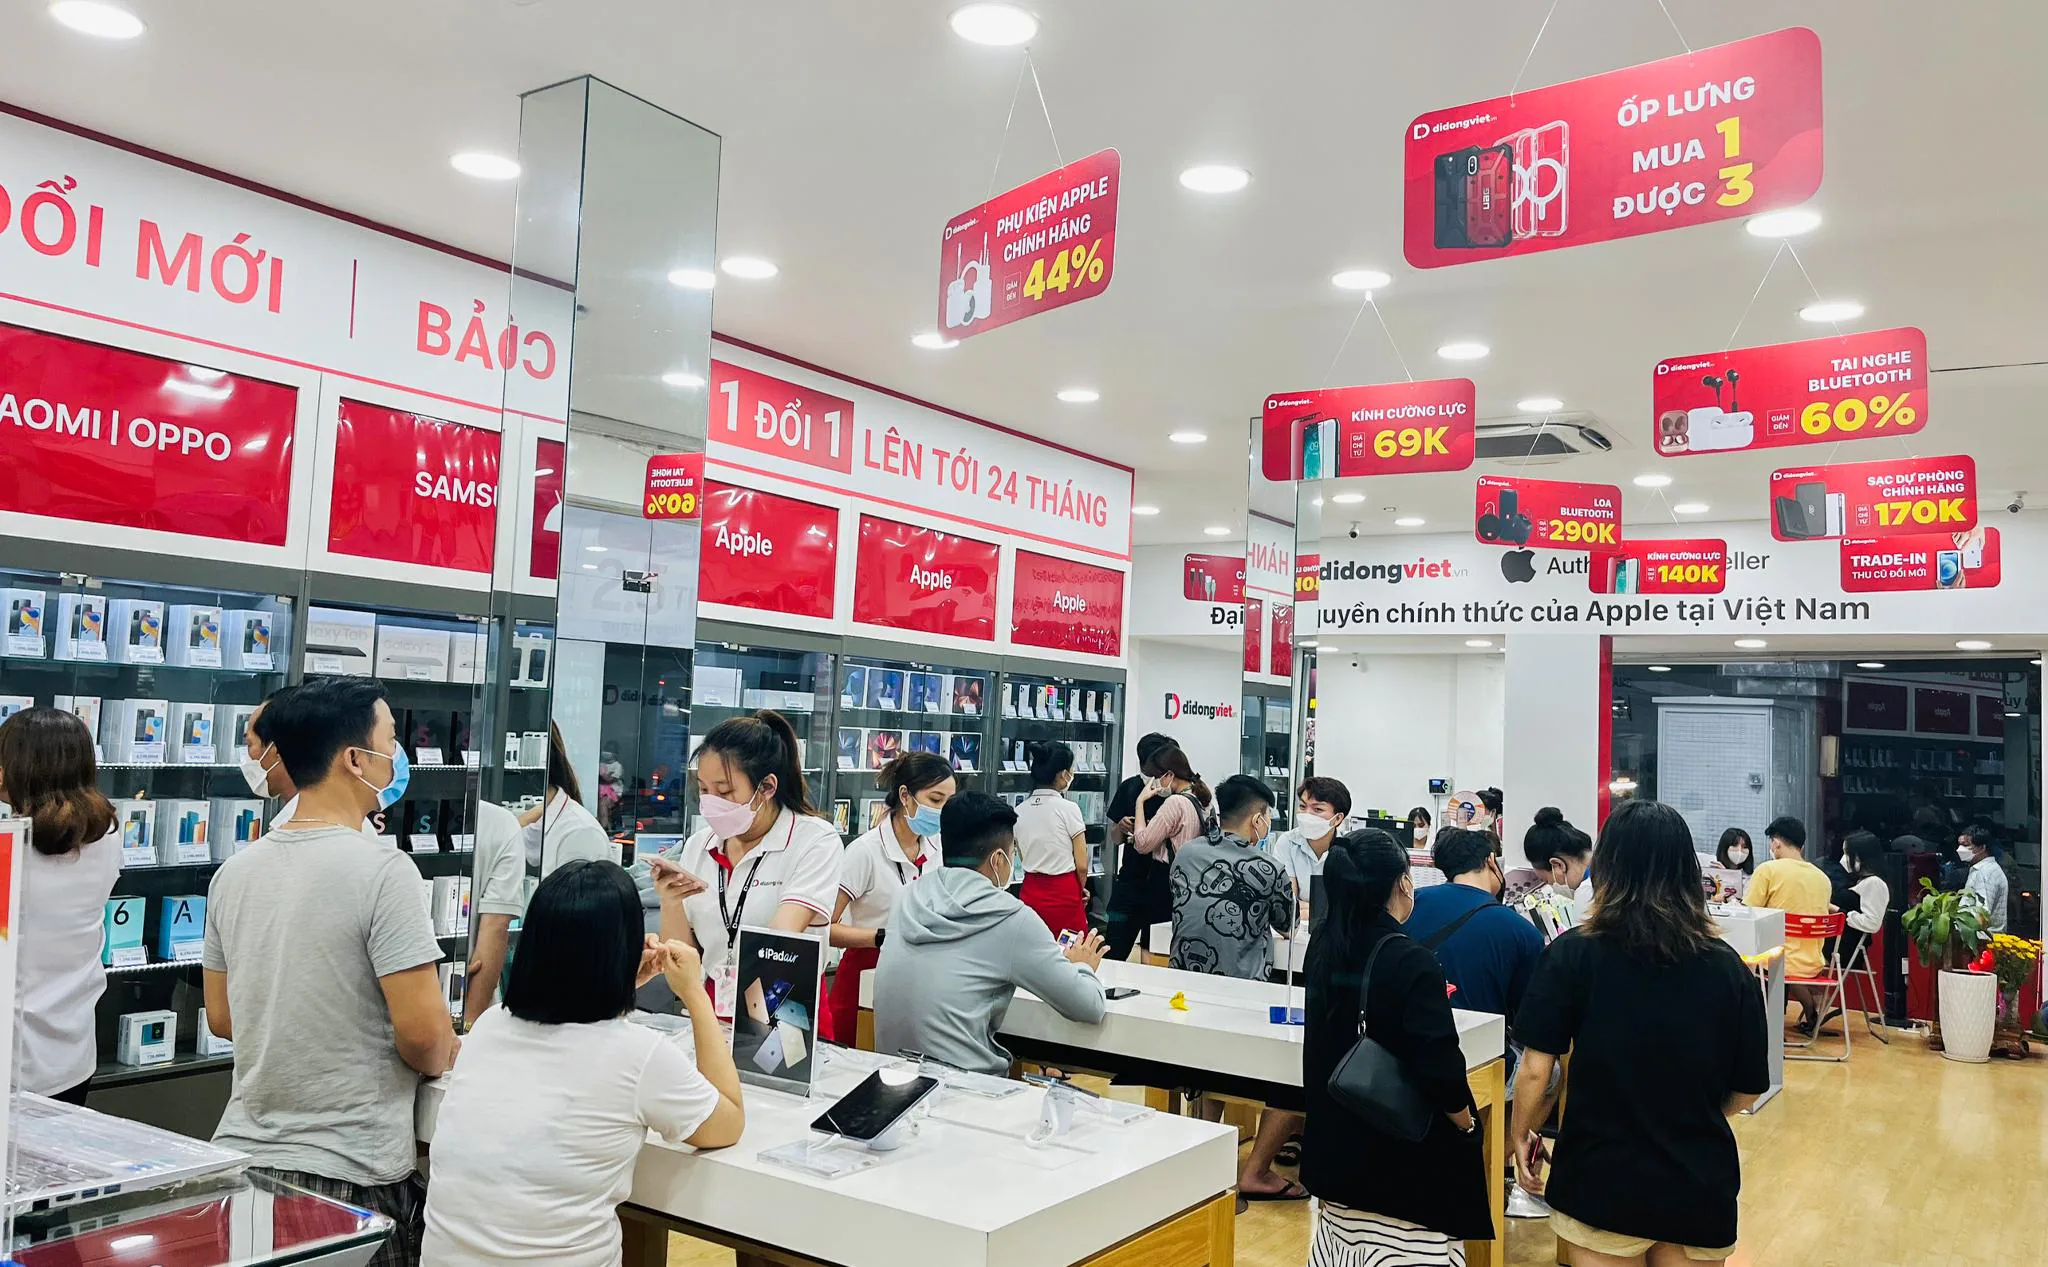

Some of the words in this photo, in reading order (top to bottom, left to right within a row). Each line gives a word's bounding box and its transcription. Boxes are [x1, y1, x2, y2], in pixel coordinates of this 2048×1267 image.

[1617, 95, 1660, 127] ỐP
[1667, 76, 1755, 116] LƯNG
[1632, 138, 1706, 173] MUA
[1715, 116, 1740, 159] 1
[1612, 181, 1706, 219] ĐƯỢC
[1716, 162, 1754, 207] 3
[996, 212, 1023, 238] PHỤ
[1025, 196, 1058, 224] KIỆN
[1059, 176, 1109, 211] APPLE
[0, 175, 104, 267] ỔI
[136, 219, 283, 314] MỚI
[1003, 230, 1046, 262] CHÍNH
[1048, 213, 1092, 246] HÃNG
[1023, 238, 1104, 301] 44%
[1831, 355, 1859, 372] TAI
[1862, 350, 1912, 368] NGHE
[1808, 368, 1912, 392] BLUETOOTH
[720, 380, 739, 432] 1
[754, 398, 811, 451] ĐỔI
[824, 410, 840, 458] 1
[1351, 408, 1384, 422] KÍNH
[1386, 404, 1435, 419] CƯỜNG
[1438, 402, 1467, 418] LỰC
[1800, 392, 1916, 435] 60%
[0, 393, 102, 440] AOMI
[128, 417, 232, 461] OPPO
[1373, 426, 1449, 458] 69K
[864, 426, 923, 480] LÊN
[932, 447, 978, 494] TỚI
[988, 465, 1018, 504] 24
[1026, 478, 1108, 527] THÁNG
[1867, 474, 1894, 488] SẠC
[1895, 471, 1917, 486] DỰ
[1918, 469, 1964, 483] PHÒNG
[1882, 484, 1925, 497] CHÍNH
[1926, 481, 1965, 494] HÃNG
[415, 471, 496, 508] SAMS
[1560, 507, 1614, 519] BLUETOOTH
[1593, 498, 1612, 508] LOA
[1874, 498, 1968, 526] 170K
[715, 526, 773, 557] Apple
[1549, 519, 1616, 544] 290K
[1647, 552, 1669, 560] KÍNH
[1703, 552, 1721, 561] LỰC
[1851, 553, 1927, 567] TRADE-IN
[910, 565, 952, 590] Apple
[1658, 565, 1719, 583] 140K
[1852, 570, 1872, 579] THU
[1873, 568, 1888, 578] CŨ
[1889, 567, 1907, 578] ĐỔI
[1908, 566, 1927, 577] MỚI
[1053, 591, 1086, 612] Apple
[1210, 605, 1244, 629] Đại
[1318, 601, 1380, 629] uyền
[1386, 602, 1455, 624] chính
[1463, 600, 1524, 623] thức
[1530, 599, 1578, 622] của
[1586, 599, 1669, 627] Apple
[1676, 599, 1715, 626] tại
[1722, 596, 1786, 626] Việt
[1796, 598, 1870, 621] Nam
[373, 813, 386, 834] S
[419, 815, 431, 833] S
[113, 901, 129, 925] 6
